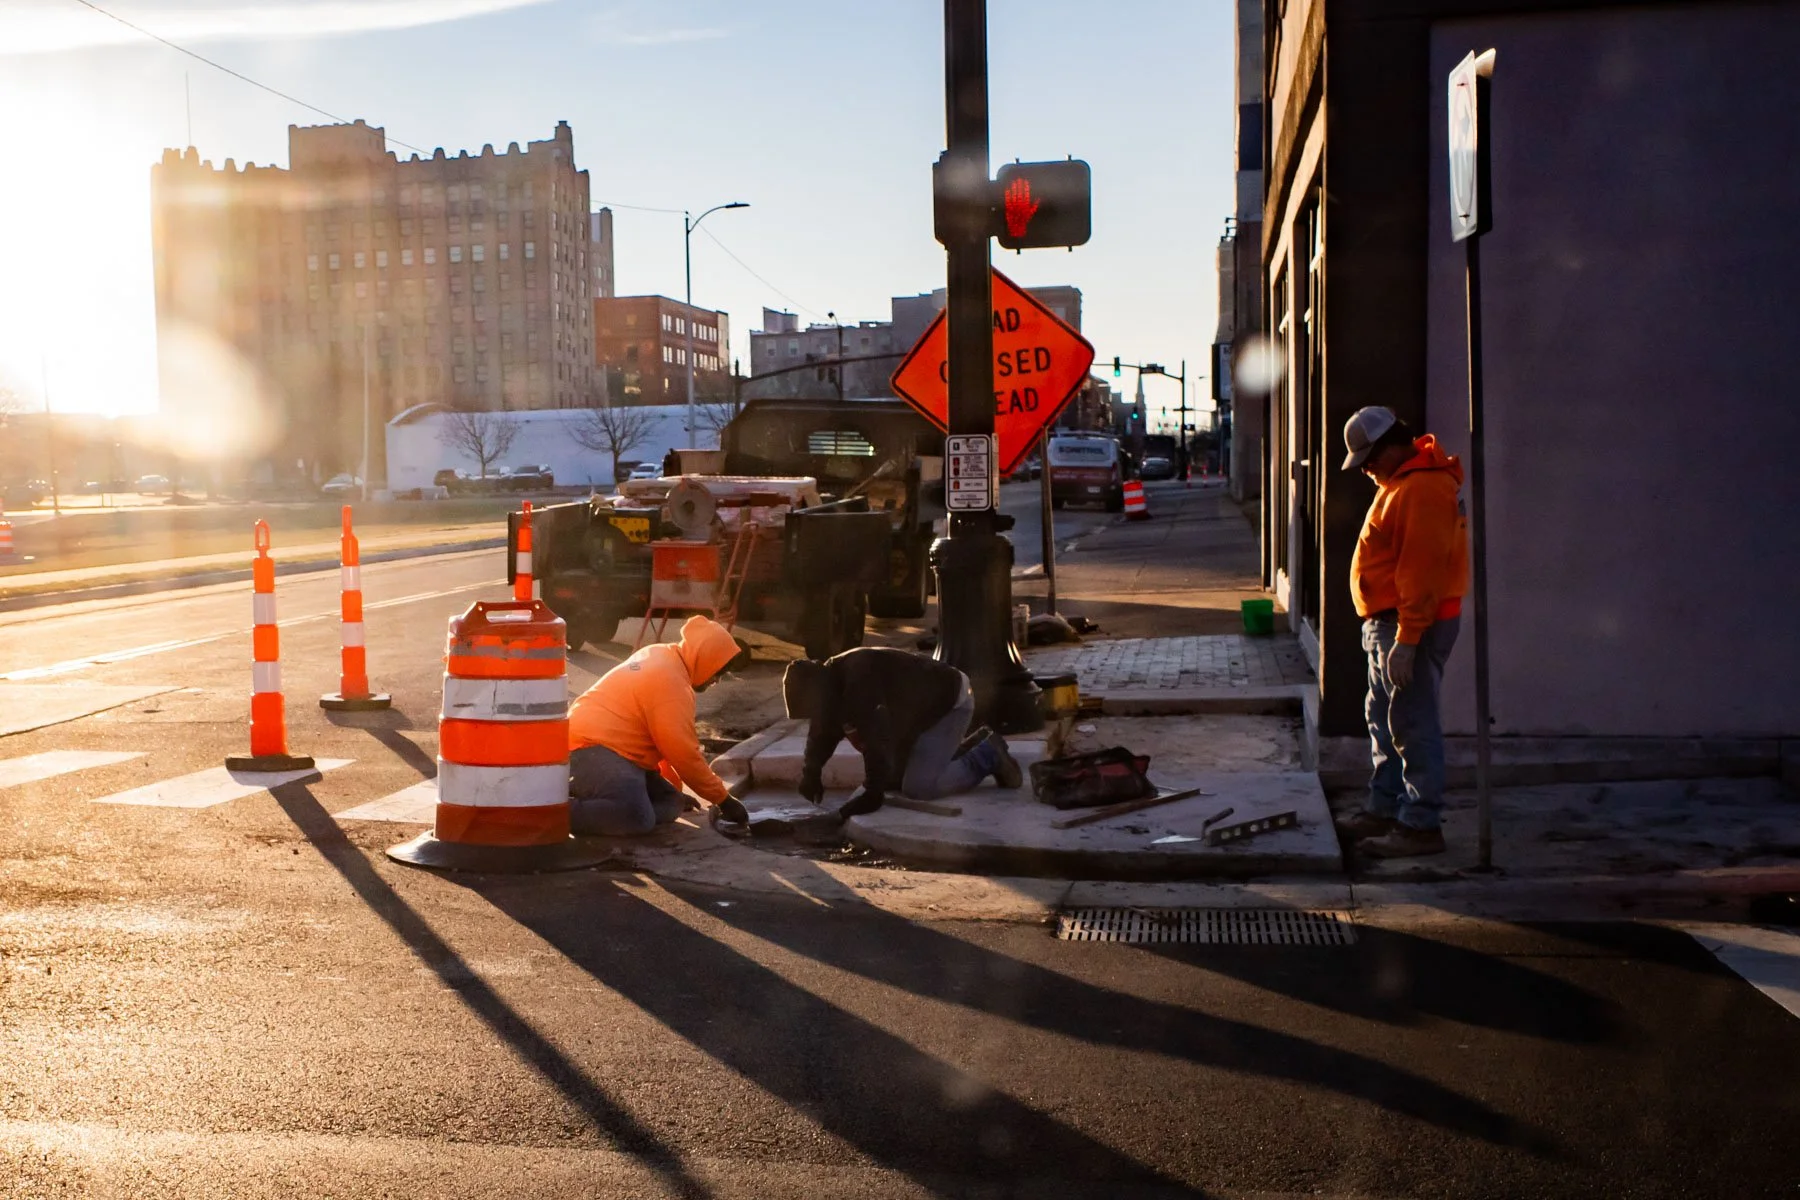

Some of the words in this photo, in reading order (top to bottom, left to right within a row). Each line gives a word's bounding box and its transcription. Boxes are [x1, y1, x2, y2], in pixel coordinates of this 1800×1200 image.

[993, 308, 1020, 333] AD
[939, 347, 1051, 383] CSED
[994, 387, 1039, 416] EAD
